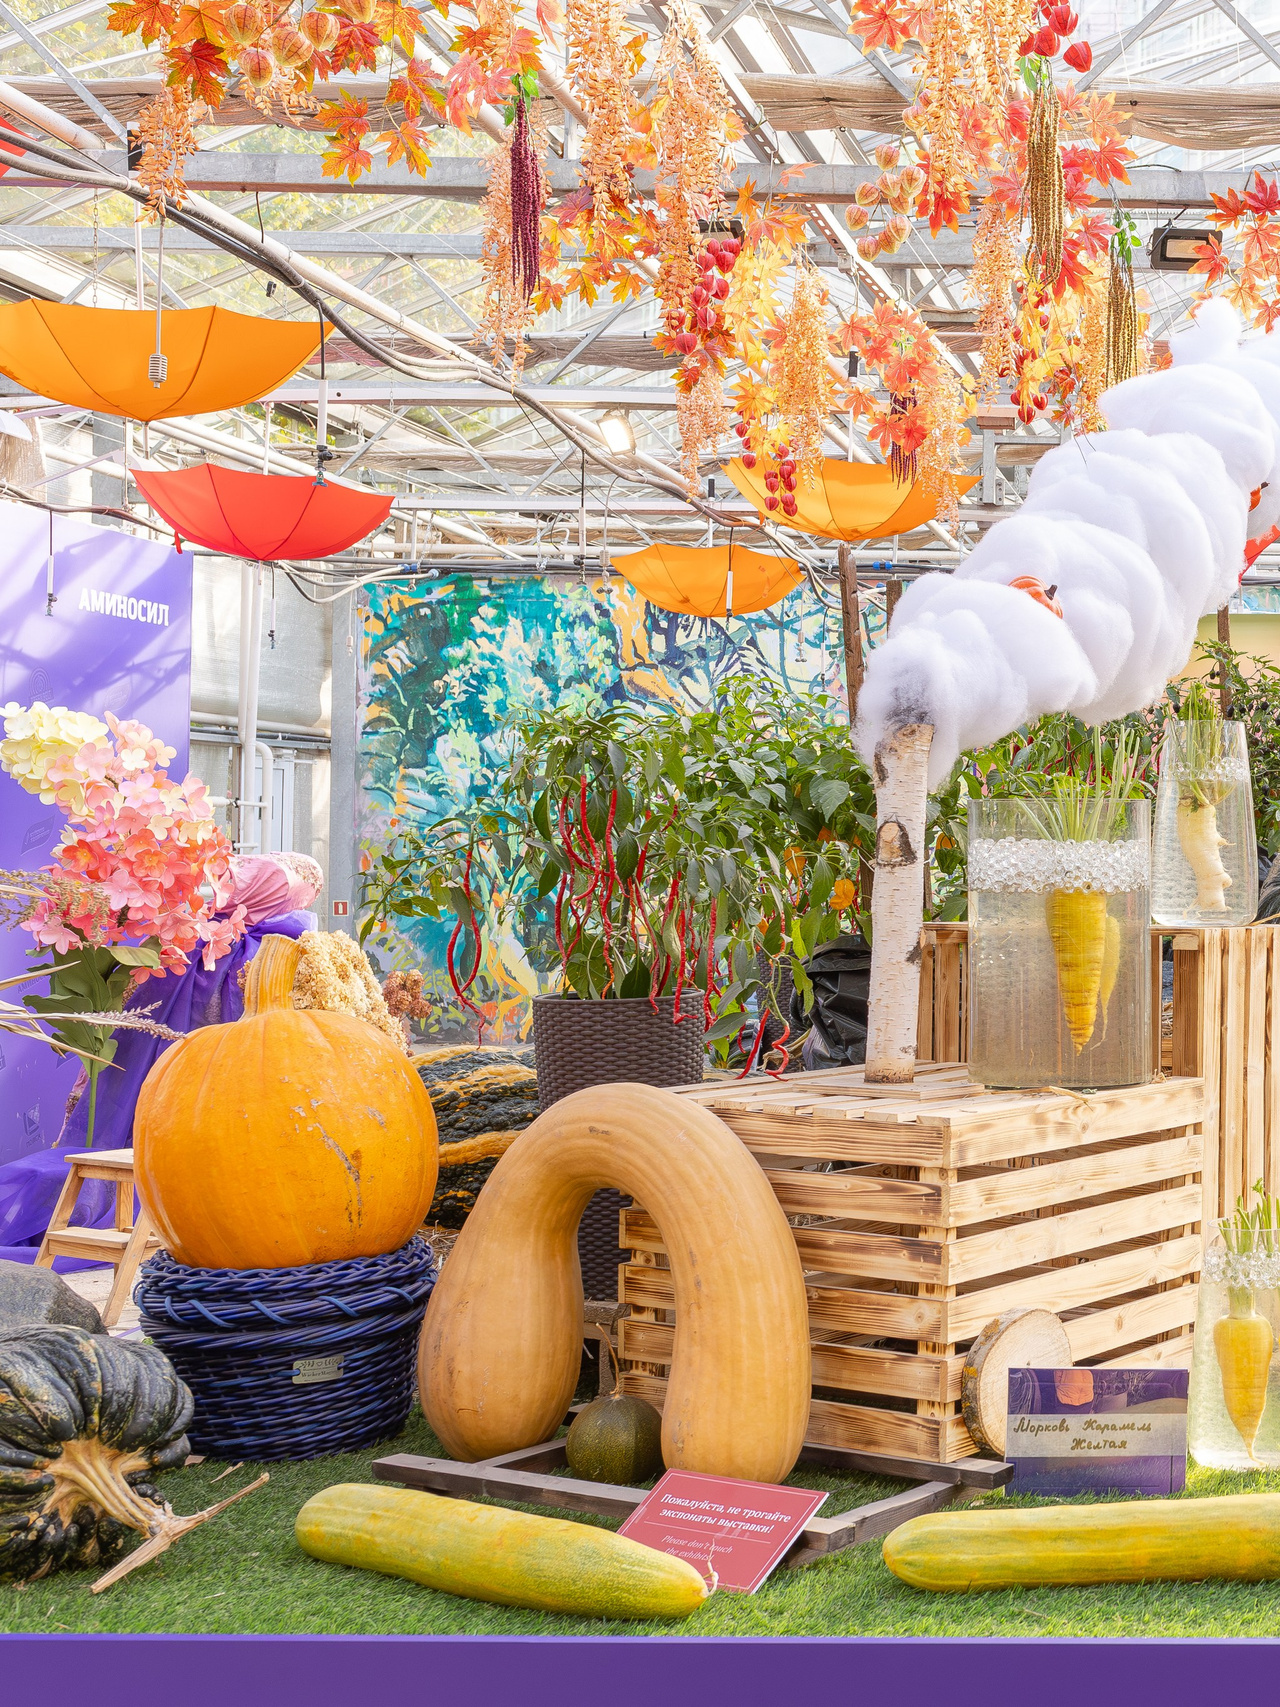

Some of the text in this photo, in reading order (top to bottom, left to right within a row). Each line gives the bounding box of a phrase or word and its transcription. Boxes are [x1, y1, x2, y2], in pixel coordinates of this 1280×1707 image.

[78, 587, 169, 627] АМИНОСИЛ
[1013, 1417, 1070, 1437] Морковь
[1070, 1437, 1128, 1451] Желтая
[660, 1493, 792, 1523] Пожалуйста, не трогайте
[659, 1508, 775, 1534] экспонаты выставки!
[661, 1535, 688, 1546] Please
[687, 1540, 710, 1550] don't
[664, 1546, 679, 1555] the
